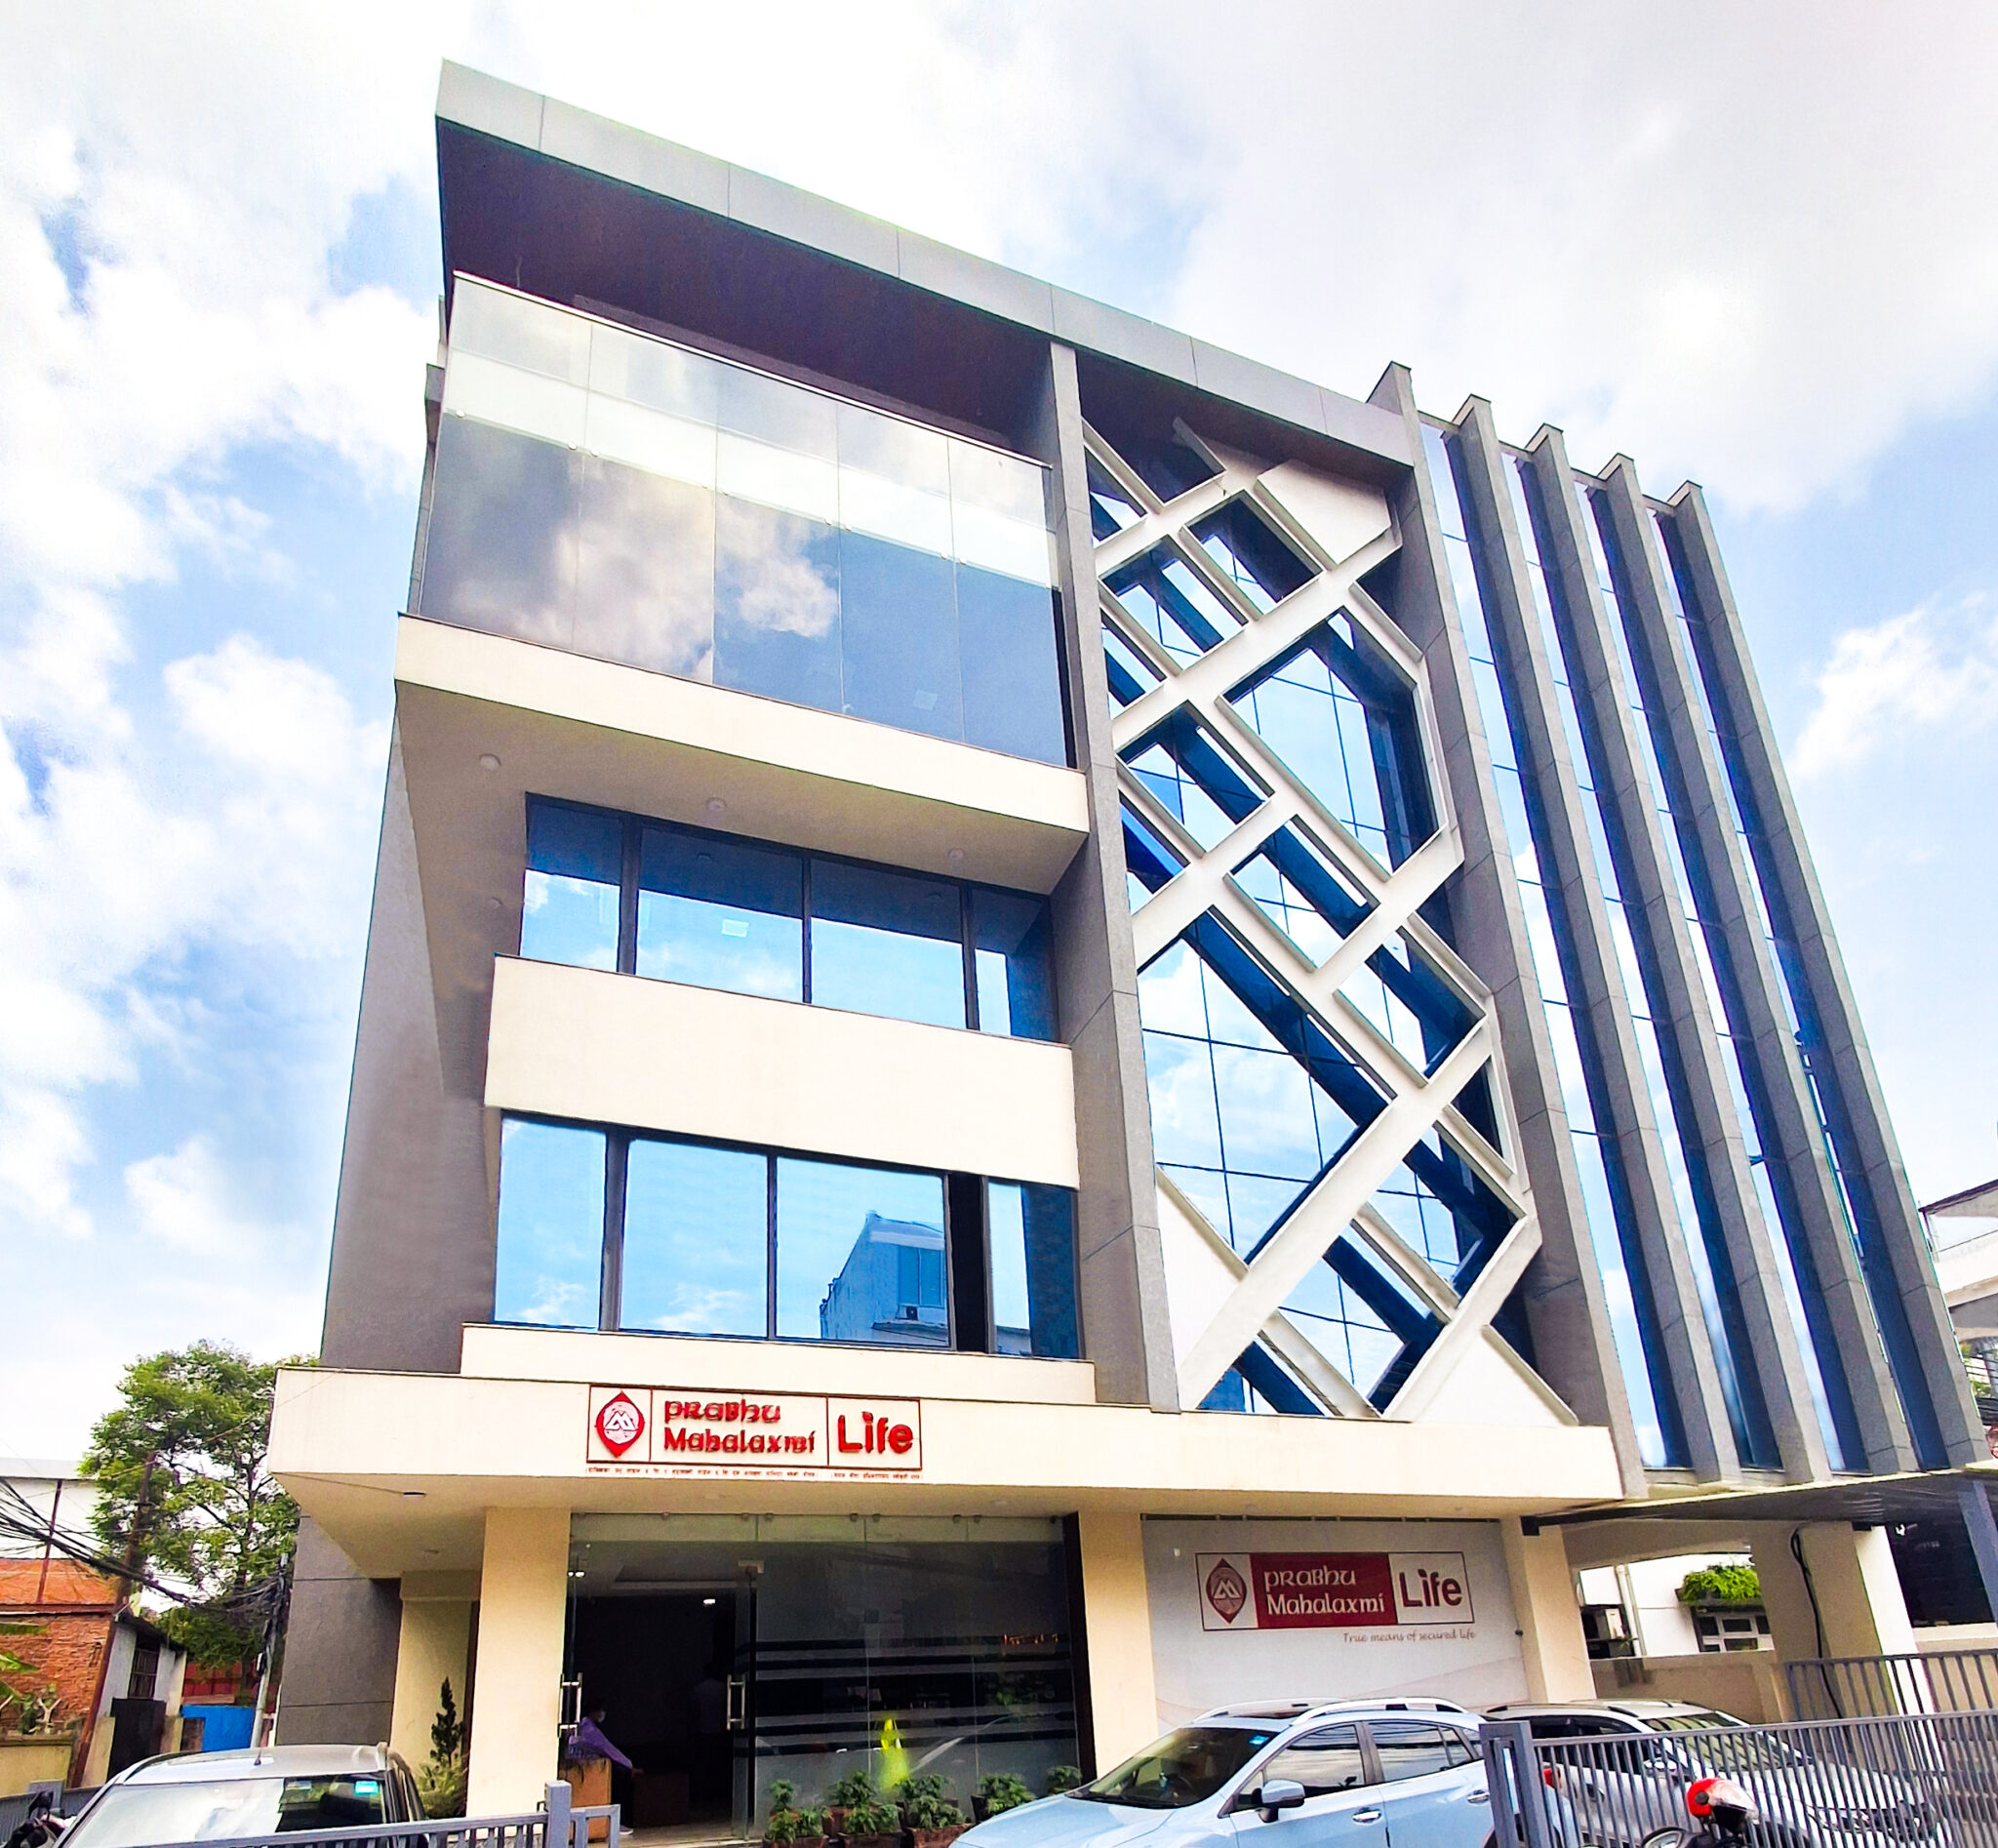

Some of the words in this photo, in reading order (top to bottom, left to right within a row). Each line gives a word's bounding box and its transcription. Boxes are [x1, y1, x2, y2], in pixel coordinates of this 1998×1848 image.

[837, 1411, 914, 1454] Life
[1398, 1568, 1462, 1608] Life
[1343, 1632, 1367, 1643] True
[1370, 1633, 1404, 1643] means
[1406, 1629, 1417, 1642] of
[1419, 1628, 1457, 1640] secured
